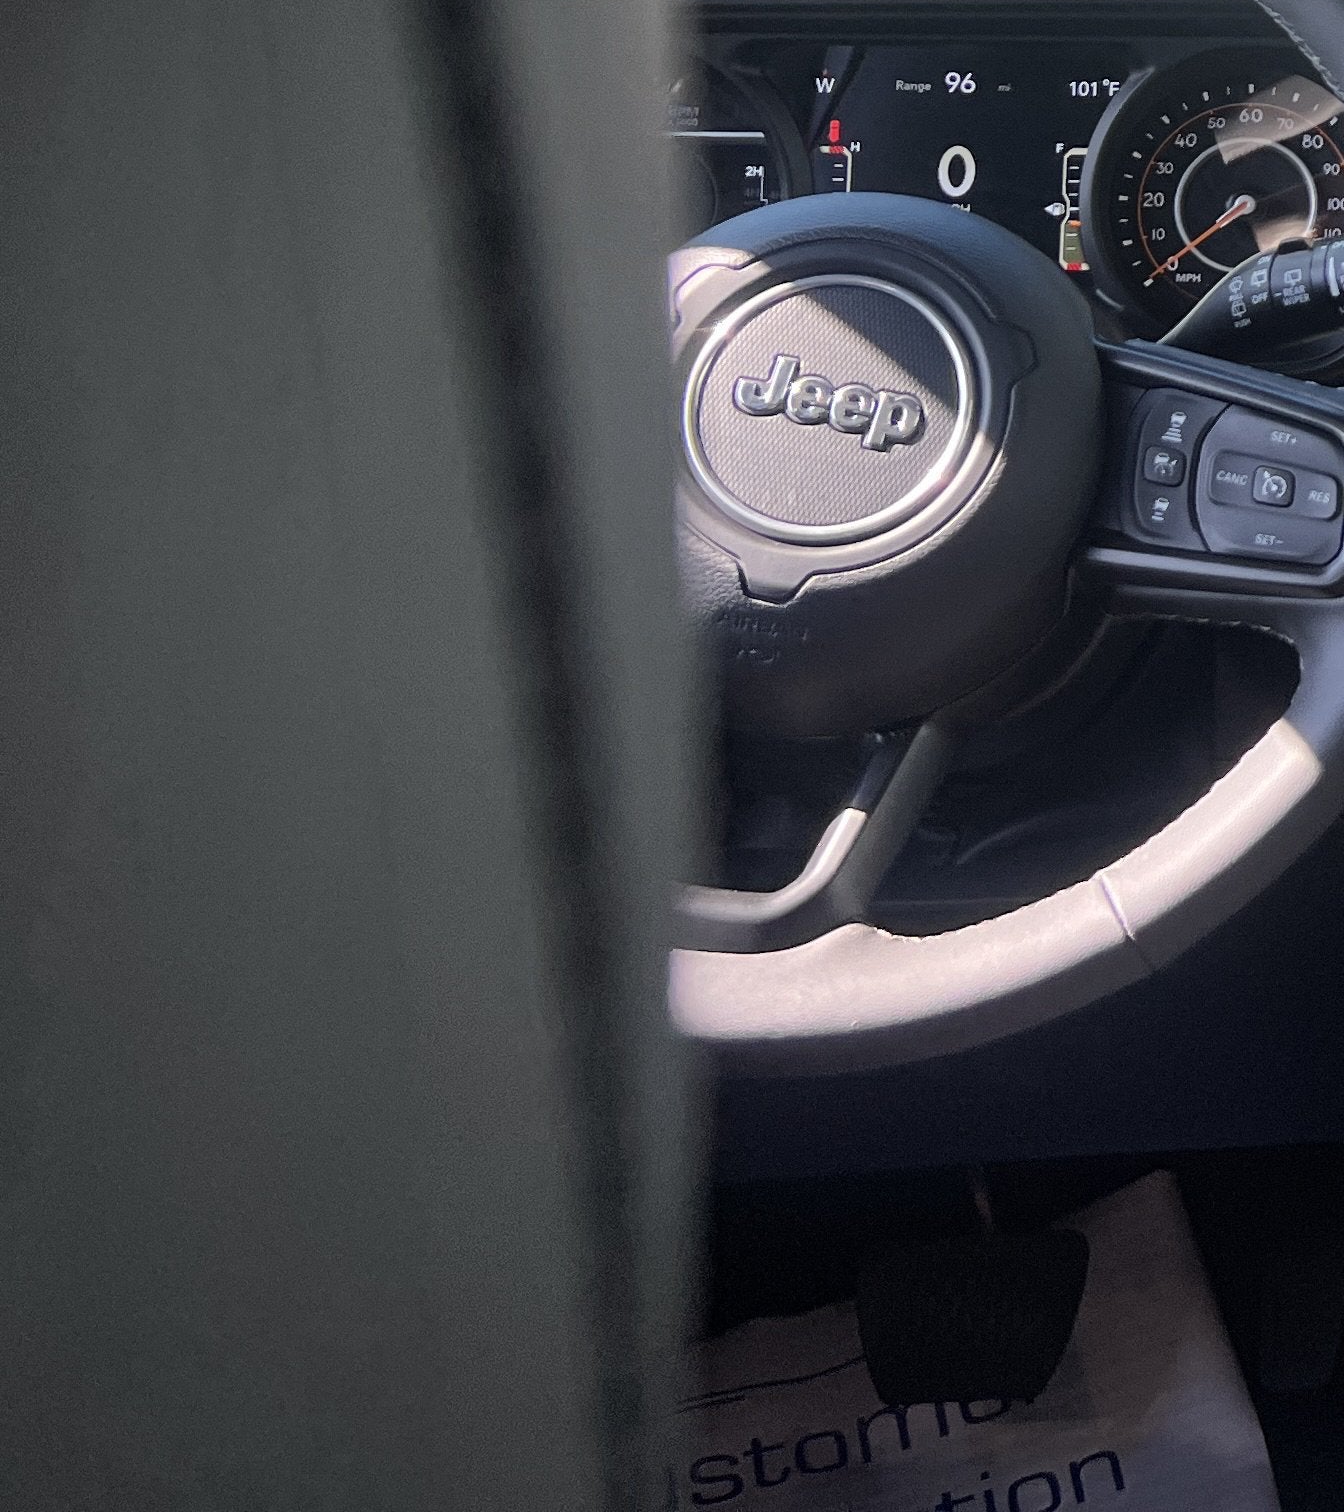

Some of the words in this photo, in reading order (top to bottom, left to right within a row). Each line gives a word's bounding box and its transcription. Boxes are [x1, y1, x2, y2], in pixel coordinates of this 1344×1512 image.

[816, 77, 837, 94] W
[895, 80, 932, 94] Range
[944, 71, 977, 94] 96
[1069, 81, 1099, 97] 101
[1239, 108, 1264, 123] 60
[1207, 117, 1226, 129] 50
[1276, 117, 1294, 129] 70
[850, 141, 861, 153] H
[1174, 133, 1198, 147] 40
[1302, 134, 1324, 149] 80
[1055, 142, 1065, 154] F
[937, 144, 977, 198] 0
[1155, 161, 1174, 175] 30
[1323, 162, 1341, 175] 90
[1143, 192, 1165, 208] 20
[1151, 228, 1166, 241] 10
[1175, 272, 1202, 283] MPH
[732, 353, 927, 453] Jeep
[1216, 470, 1249, 486] CANC
[1307, 490, 1331, 503] RES
